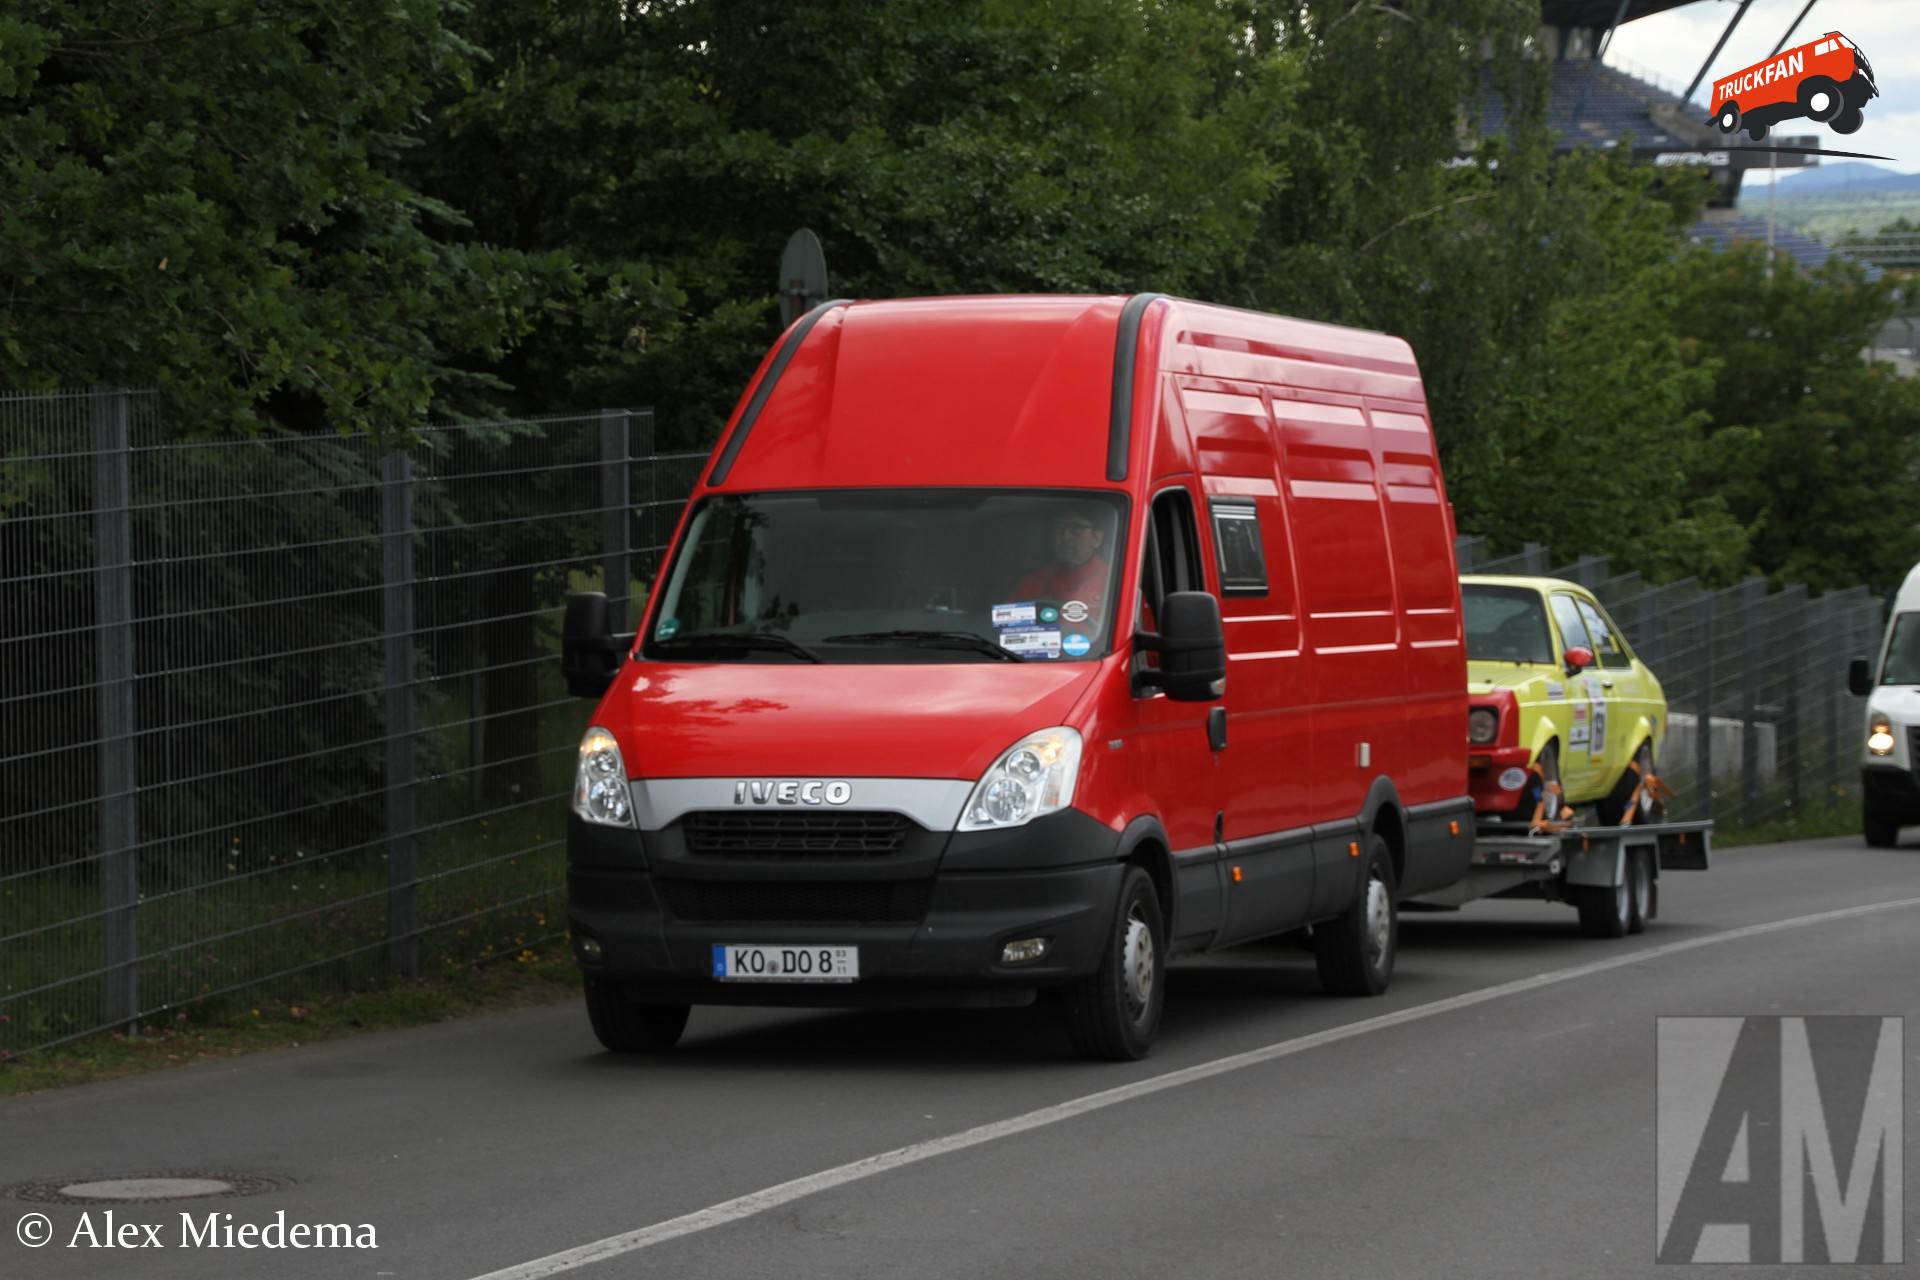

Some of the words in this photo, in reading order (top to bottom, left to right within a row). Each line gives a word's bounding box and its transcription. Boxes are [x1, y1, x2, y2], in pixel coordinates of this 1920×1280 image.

[734, 780, 853, 806] IVECO
[734, 949, 765, 974] KO
[781, 949, 812, 974] DO
[819, 949, 833, 974] 8
